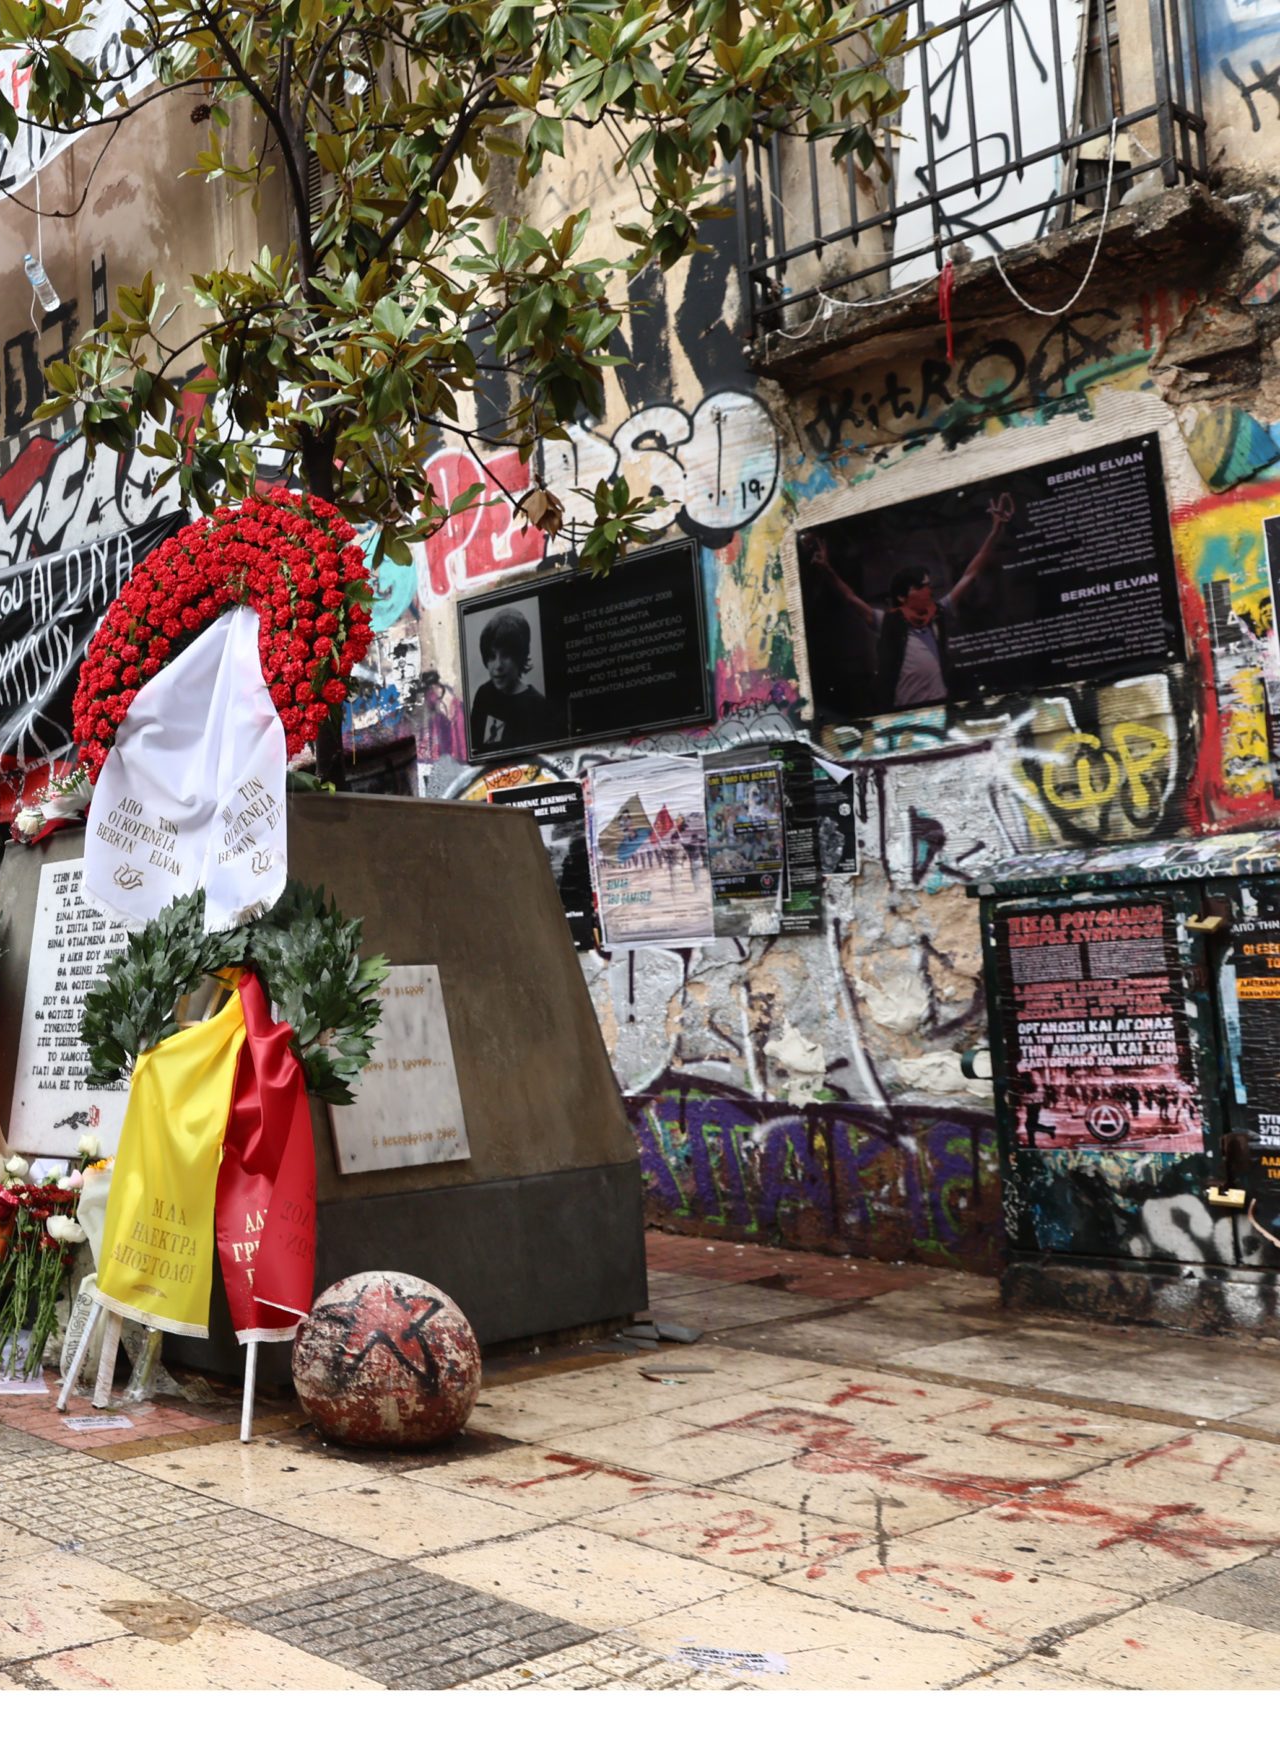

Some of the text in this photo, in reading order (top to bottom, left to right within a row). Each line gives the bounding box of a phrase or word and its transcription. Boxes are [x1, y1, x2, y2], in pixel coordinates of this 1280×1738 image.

[1047, 451, 1144, 486] BERKİN ELVAN
[1060, 573, 1160, 603] BERKİN ELVAN
[118, 797, 143, 817] ΑΠΟ
[108, 810, 176, 853] ΟΙΚΟΓΕΝΕΙΑ
[96, 822, 183, 876] BERKIN ELVAN
[72, 870, 83, 880] ΜΝ
[55, 884, 68, 895] ΔΕΝ
[56, 912, 74, 922] ΕΙΝΑΙ
[1007, 904, 1164, 933] ΠΙΣΩ ΡΟΥΦΙΑΝΟΙ
[55, 920, 107, 935] ΤΑ ΣΠΙΤΙΑ ΤΩΝ
[47, 933, 125, 949] ΕΙΝΑΙ ΦΤΙΑΓΜΕΝΑ ΑΠΟ
[67, 951, 83, 962] ΔΙΚΗ
[86, 950, 101, 961] ΣΟΥ
[70, 965, 93, 976] ΜΕΙΝΕΙ
[43, 995, 70, 1005] ΠΟΥ ΘΑ
[35, 1011, 44, 1020] ΘΑ
[48, 1009, 73, 1020] ΦΩΤΙΖΕΙ
[44, 1022, 80, 1033] ΣΥΝΕΧΙΖΟΥ
[1017, 1016, 1174, 1034] ΟΡΓΑΝΩΣΗ ΚΑΙ ΑΓΩΝΑΣ
[48, 1051, 91, 1061] ΤΟ ΧΑΜΟΓΕ
[1019, 1041, 1177, 1058] ΤΗΝ ΑΝΑΡΧΙΑ ΚΑΙ ΤΟΝ
[68, 1066, 89, 1076] ΕΙΠΑΜ
[38, 1080, 56, 1090] ΑΛΛΑ
[130, 1221, 197, 1257] ΗΛΕΚΤΡΑ
